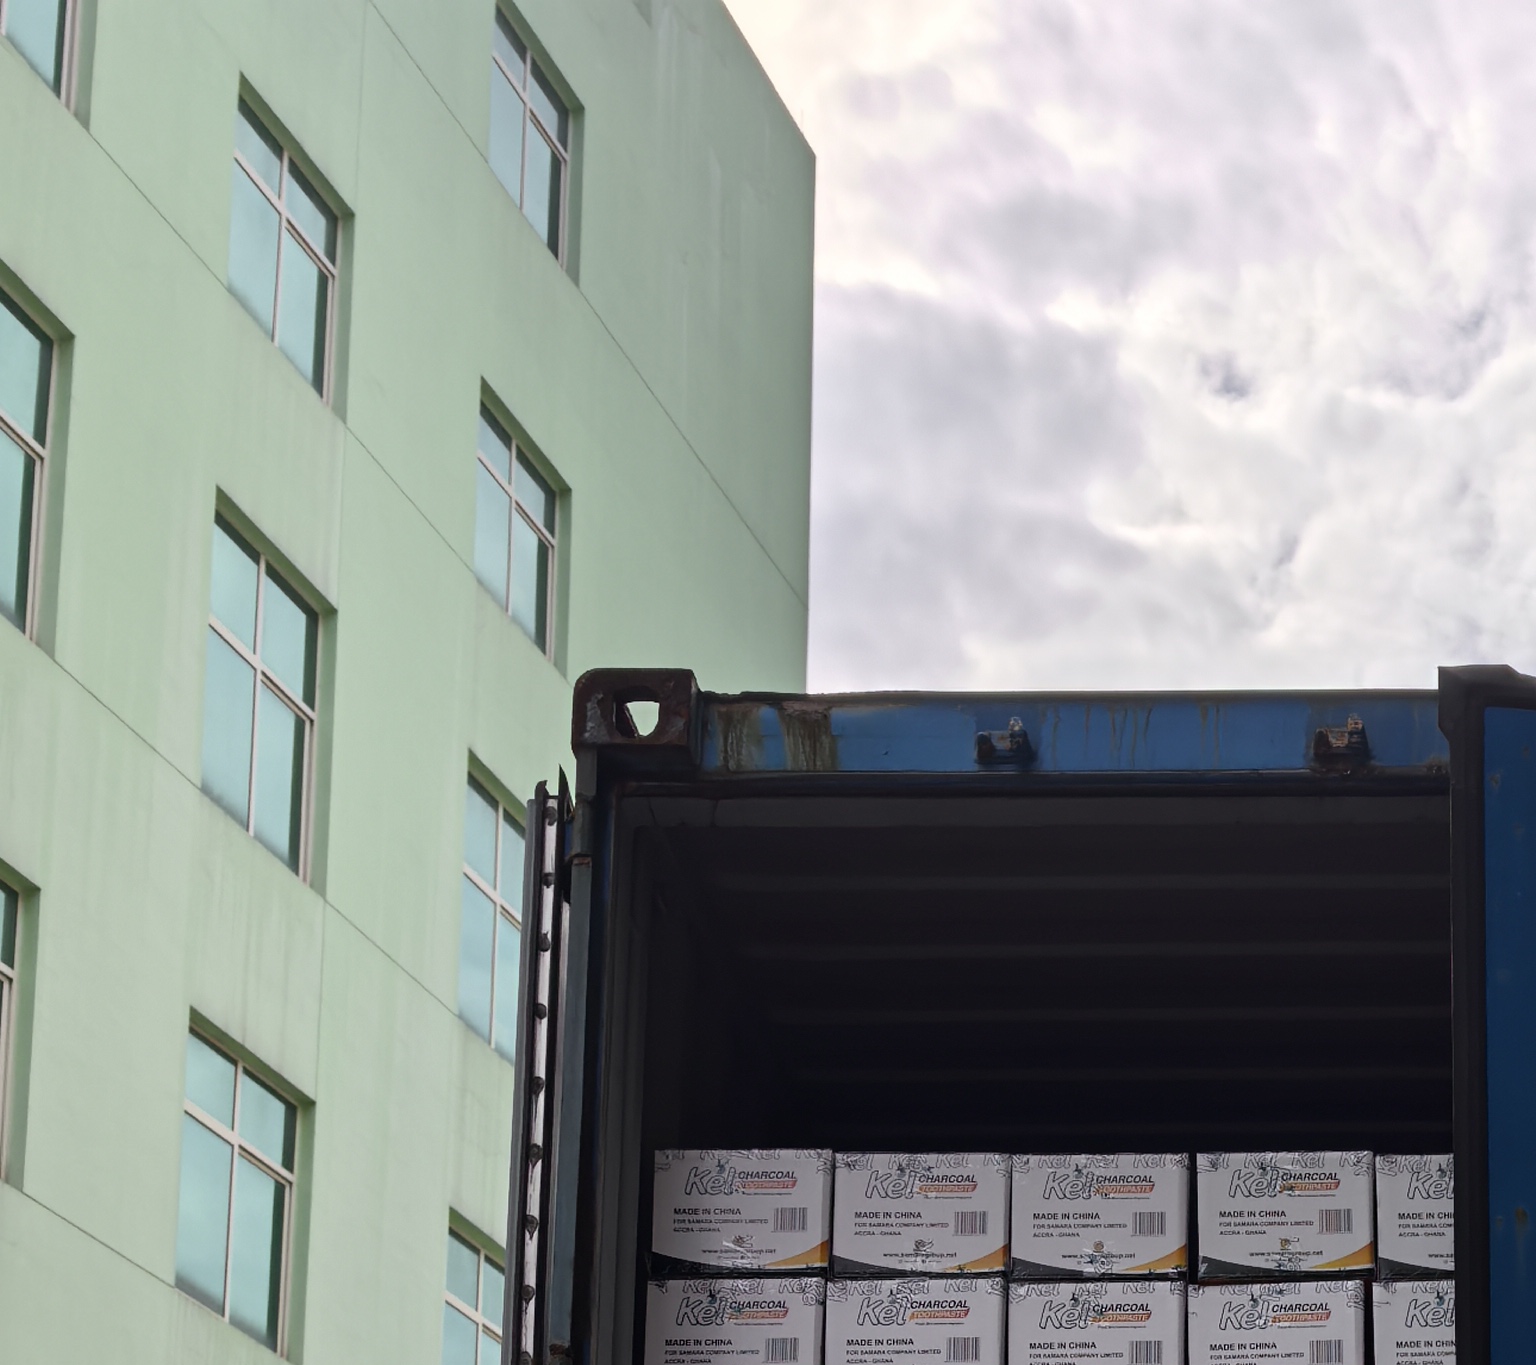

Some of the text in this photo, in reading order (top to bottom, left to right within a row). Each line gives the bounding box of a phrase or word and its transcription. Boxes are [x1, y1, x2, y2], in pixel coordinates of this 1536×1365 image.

[918, 1174, 977, 1183] CHARCOAL
[865, 1169, 916, 1200] Kel
[855, 1211, 922, 1219] MADE IN CHINA
[910, 1300, 969, 1309] CHARCOAL
[857, 1296, 908, 1326] Kel
[885, 1338, 914, 1346] CHINA
